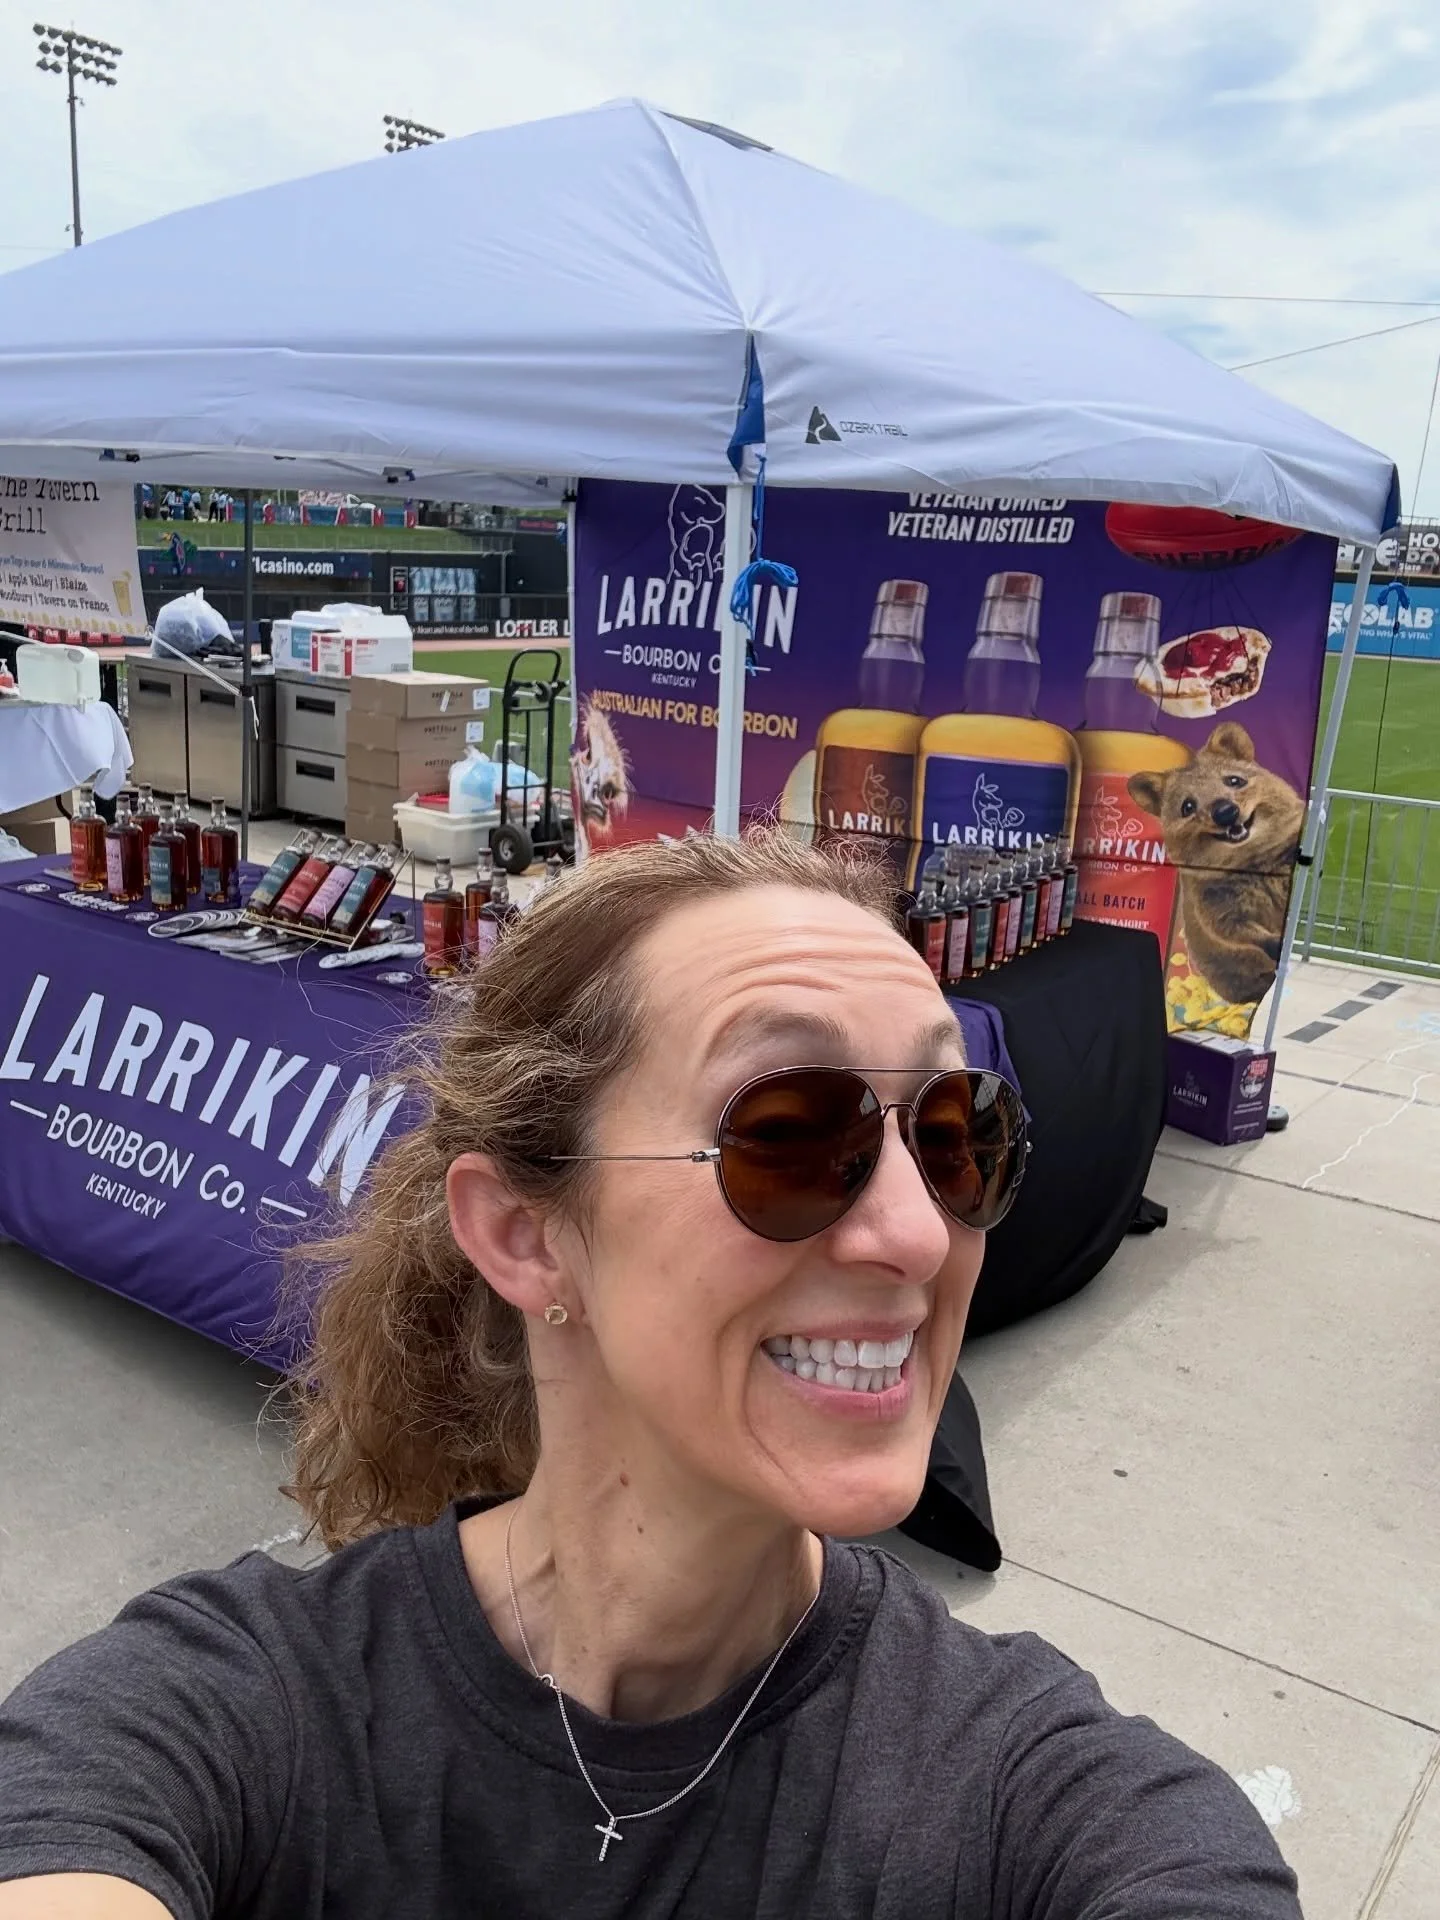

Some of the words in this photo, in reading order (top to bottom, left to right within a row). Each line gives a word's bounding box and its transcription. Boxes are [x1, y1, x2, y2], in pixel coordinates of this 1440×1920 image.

[0, 504, 47, 534] rill
[887, 511, 976, 542] VETERAN
[976, 517, 1075, 544] DISTILLED
[28, 573, 53, 591] Valley
[60, 576, 88, 592] Blaine
[79, 597, 110, 612] France
[621, 644, 701, 672] BOURBON
[651, 673, 697, 688] KENTUCKY
[591, 690, 663, 719] AUSTRALIAN
[664, 702, 698, 725] FOR
[1083, 838, 1166, 865] RRIKIN
[1103, 894, 1145, 911] BATCH
[0, 973, 406, 1208] LARRIKIN
[46, 1103, 195, 1190] BOURBON
[199, 1163, 248, 1214] Co.
[85, 1172, 167, 1220] KENTUCKY
